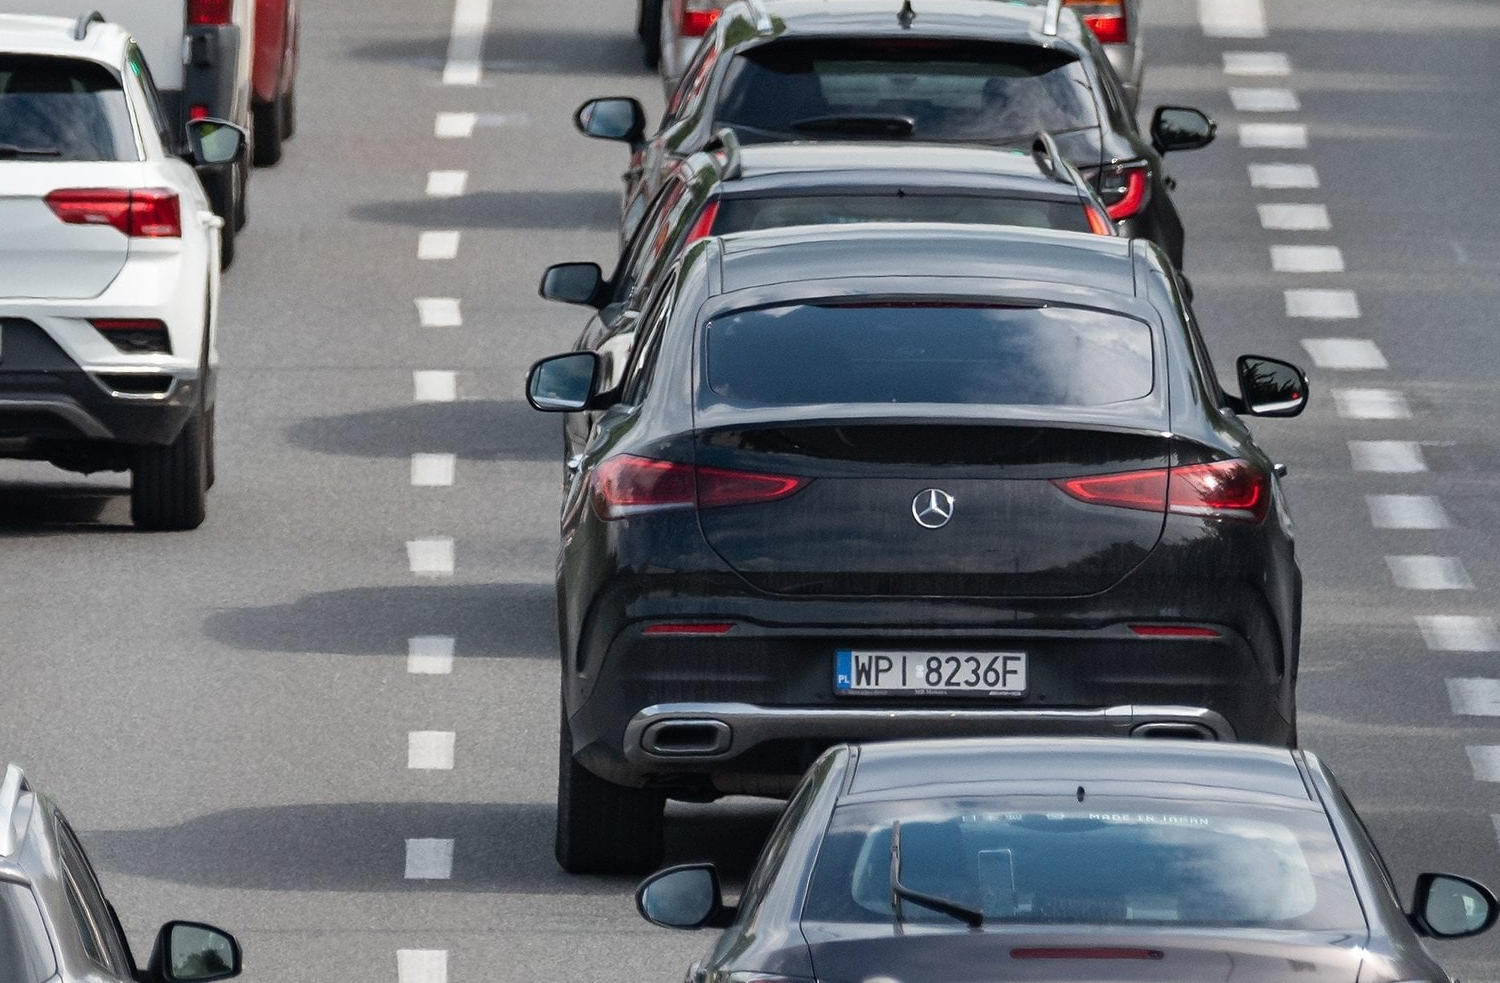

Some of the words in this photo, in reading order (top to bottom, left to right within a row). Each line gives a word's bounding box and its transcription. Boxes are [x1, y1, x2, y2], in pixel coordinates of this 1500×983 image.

[838, 674, 850, 684] PL
[854, 655, 907, 687] WPI
[924, 655, 1021, 688] 8236F
[1089, 813, 1129, 822] MADE
[1162, 816, 1209, 825] JAPAN
